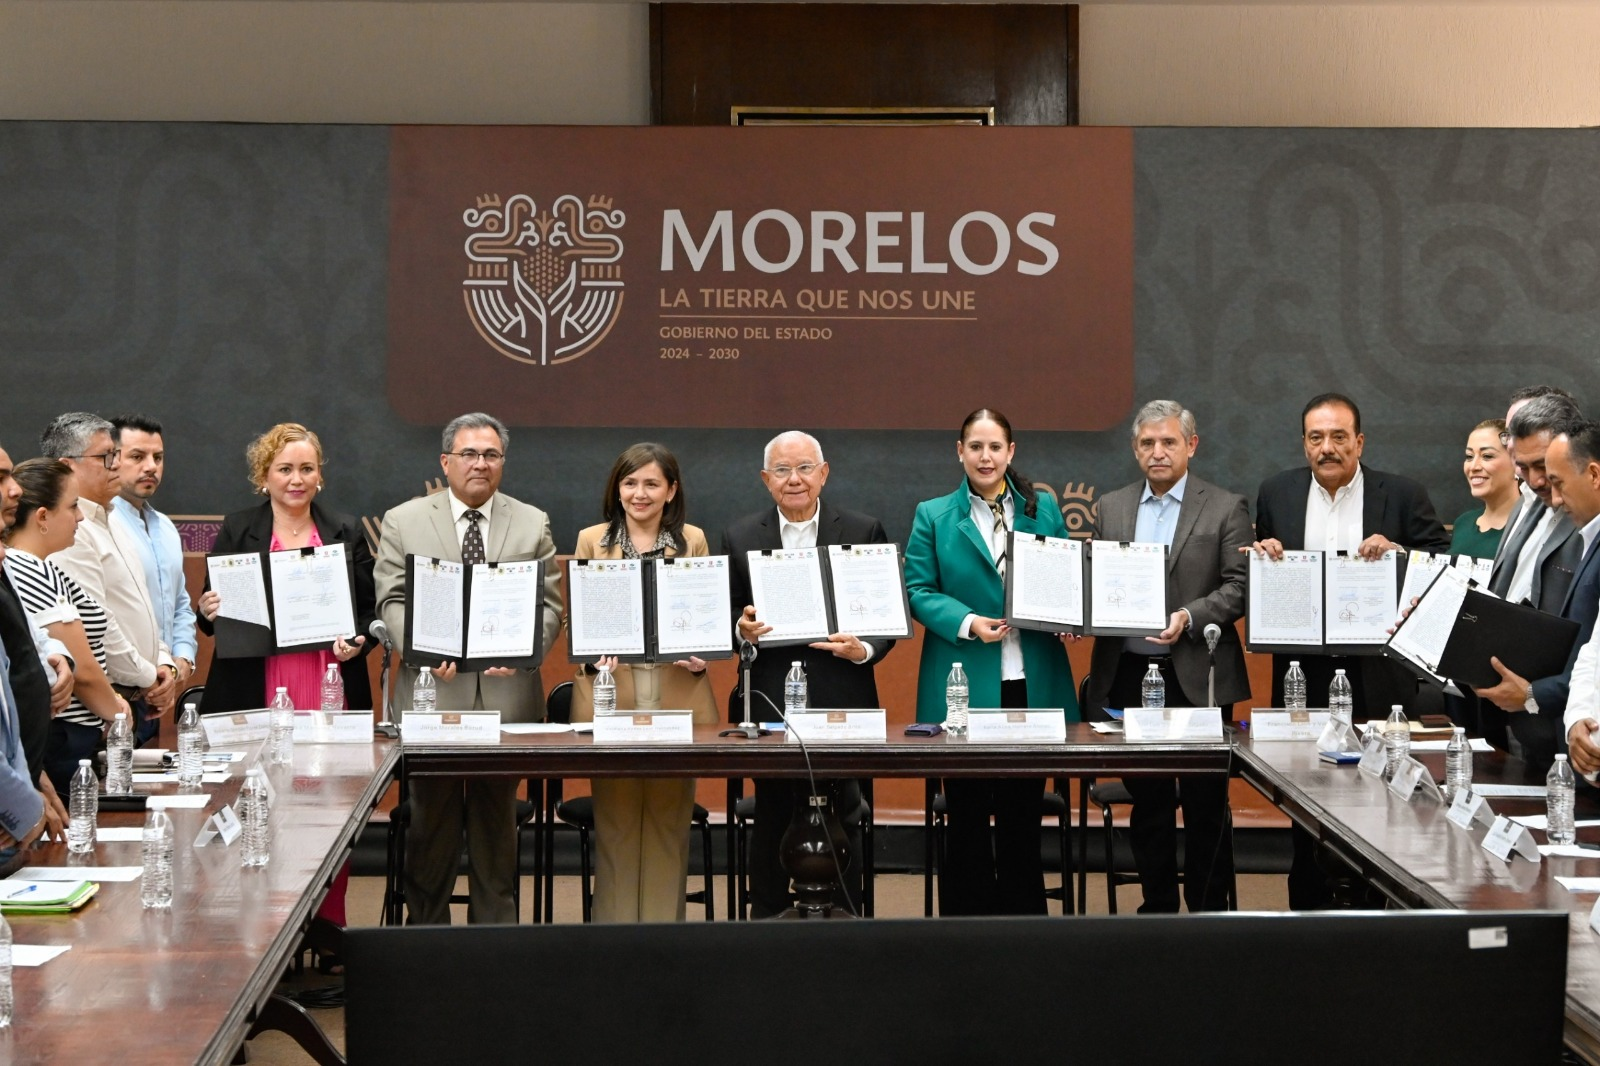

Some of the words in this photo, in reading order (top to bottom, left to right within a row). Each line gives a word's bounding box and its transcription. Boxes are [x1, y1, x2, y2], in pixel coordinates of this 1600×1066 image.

[660, 208, 1060, 276] MORELOS
[660, 288, 691, 308] LA
[699, 288, 788, 309] TIERRA
[796, 288, 849, 313] QUE
[858, 289, 913, 310] NOS
[922, 290, 976, 311] UNE
[659, 326, 739, 339] GOBIERNO
[743, 327, 771, 340] DEL
[775, 327, 833, 340] ESTADO
[660, 347, 690, 359] 2024
[708, 347, 740, 360] 2030
